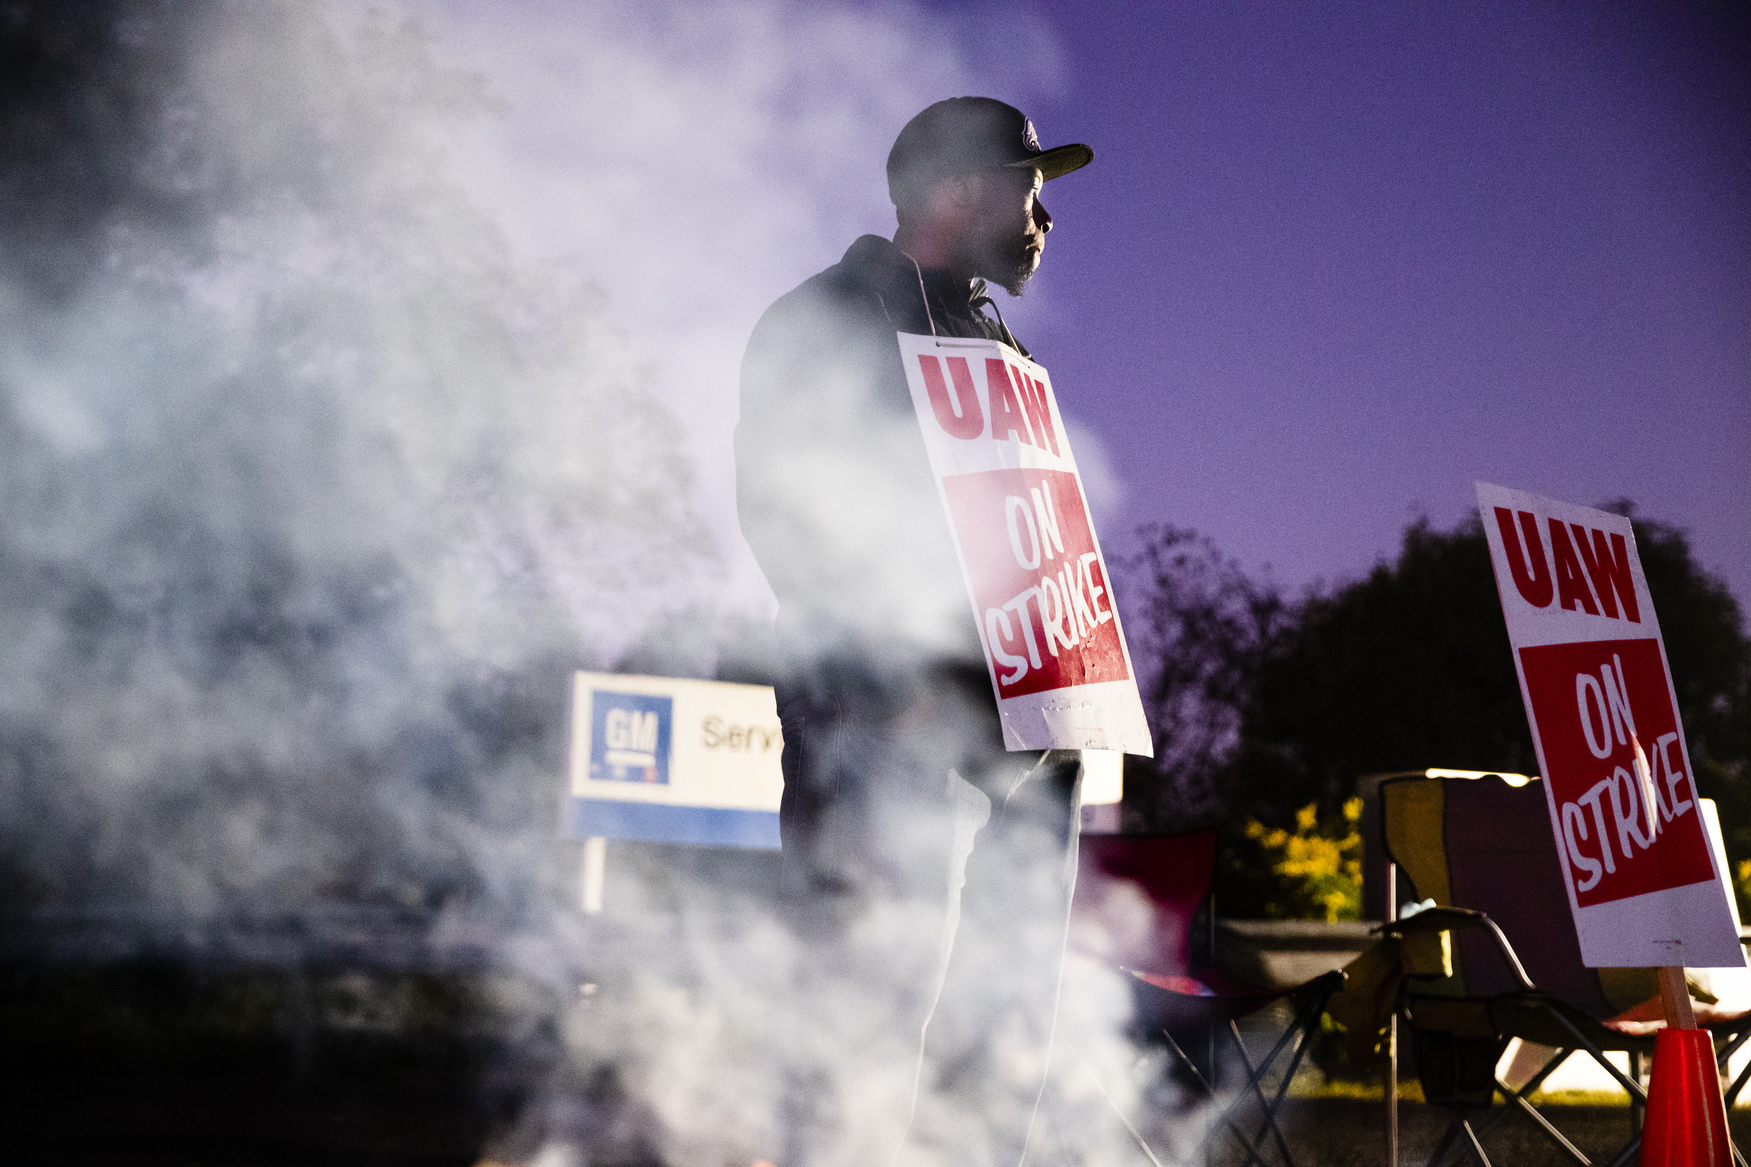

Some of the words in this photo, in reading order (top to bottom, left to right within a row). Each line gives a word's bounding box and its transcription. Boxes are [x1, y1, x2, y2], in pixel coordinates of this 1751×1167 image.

[917, 354, 1061, 458] UAW
[1005, 480, 1064, 570] ON
[1493, 506, 1641, 624] UAW
[985, 552, 1112, 687] STRIKE
[605, 708, 659, 751] GM
[1575, 653, 1637, 759] ON
